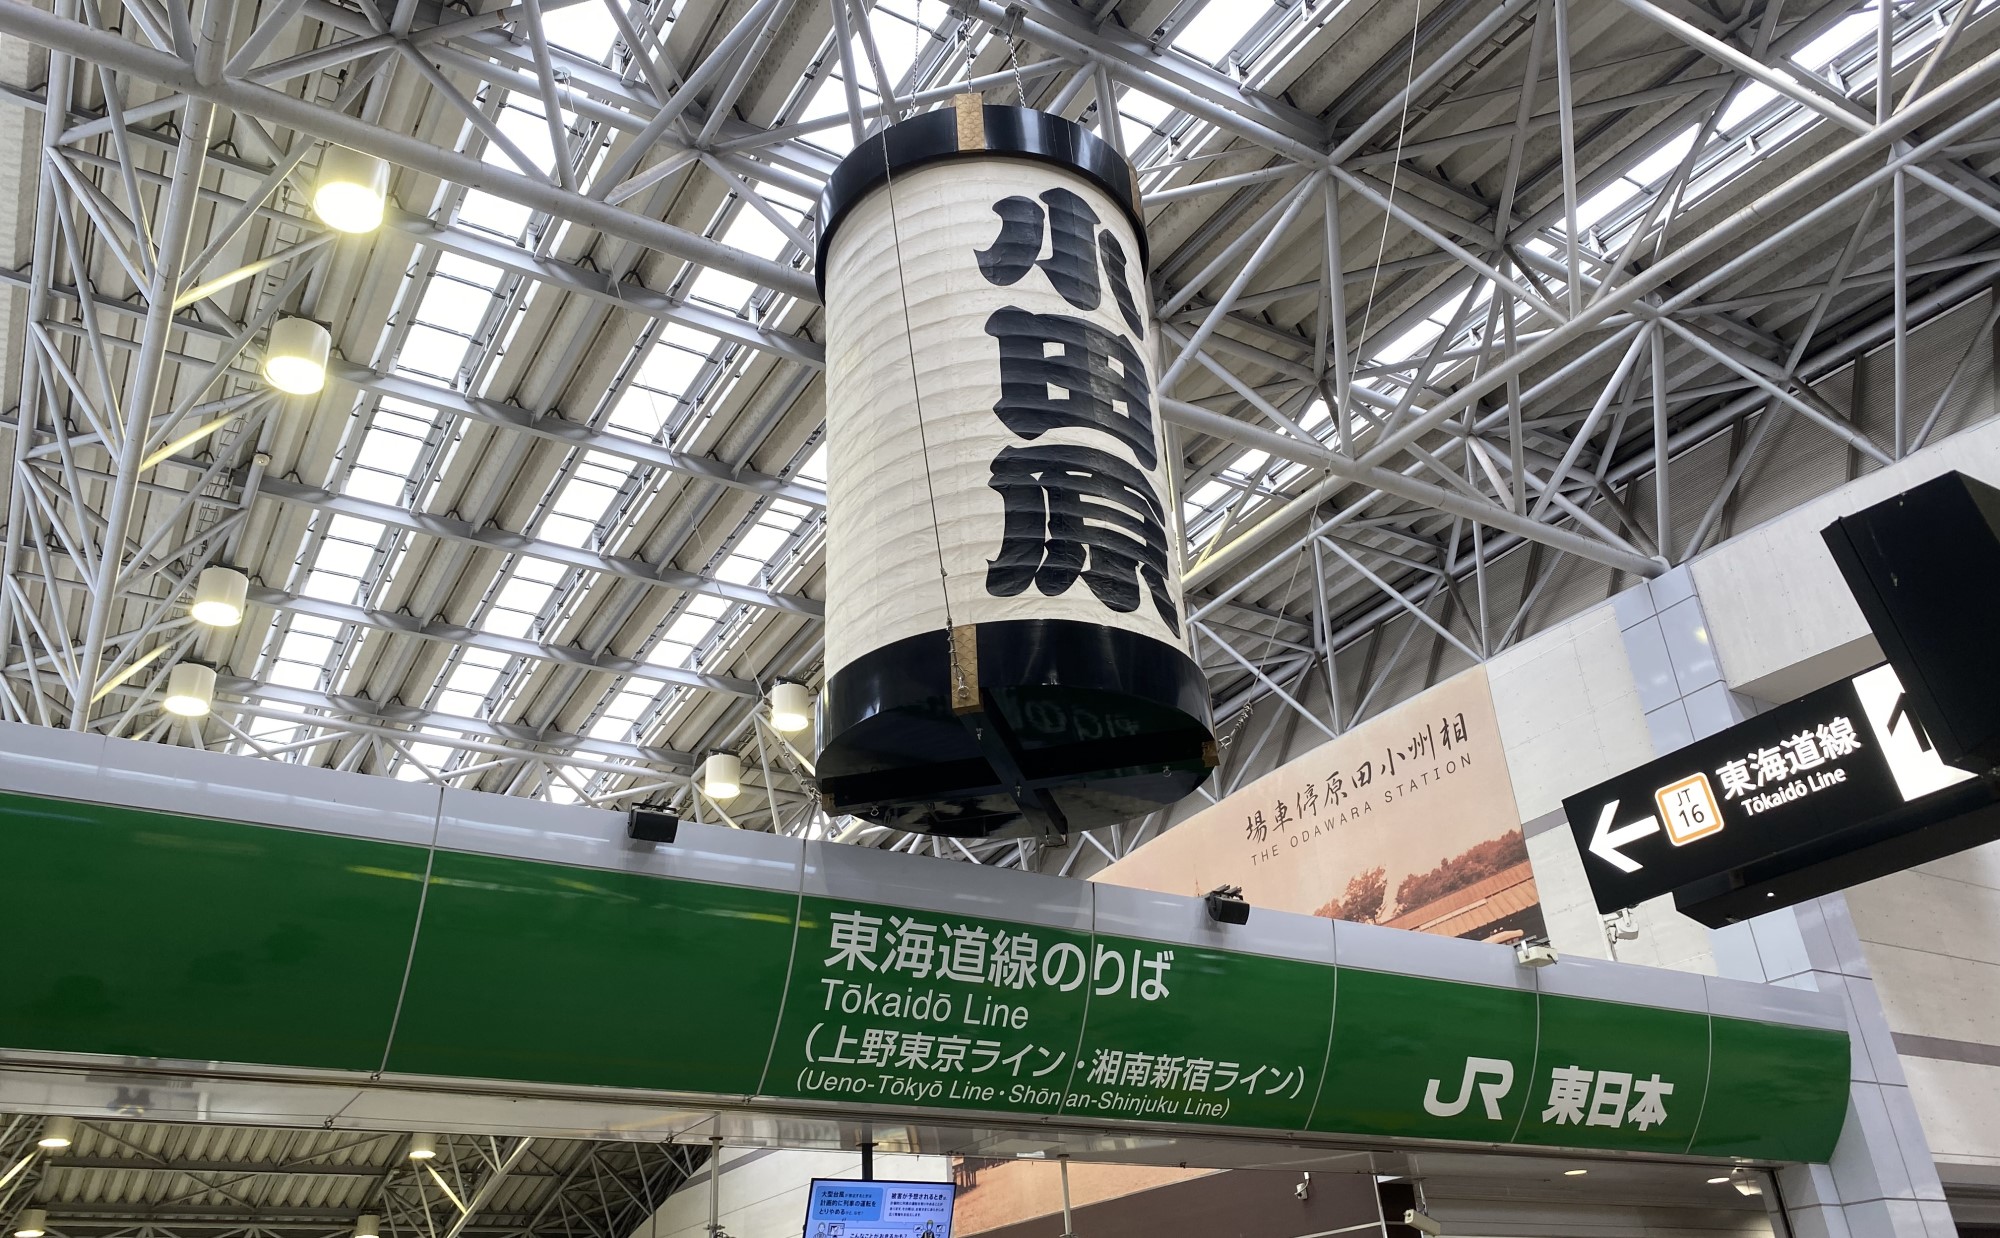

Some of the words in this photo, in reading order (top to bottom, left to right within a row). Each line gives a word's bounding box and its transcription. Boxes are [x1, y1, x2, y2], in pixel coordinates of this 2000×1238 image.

[973, 187, 1180, 639] 小田原
[1716, 716, 1861, 801] 東海道線
[1251, 845, 1279, 866] THE
[1290, 801, 1372, 848] ODAWARA
[1385, 753, 1471, 803] STATION
[1675, 788, 1692, 807] JT
[1678, 808, 1705, 828] 16
[1741, 779, 1808, 818] Tōkaidō
[1810, 767, 1848, 793] Line
[824, 911, 1174, 1001] 東海道線のりば
[821, 978, 951, 1023] Tōkaidō
[963, 994, 1029, 1030] Line
[1184, 1097, 1230, 1119] Line)
[1423, 1056, 1514, 1120] JR
[1542, 1065, 1674, 1132] 東日本
